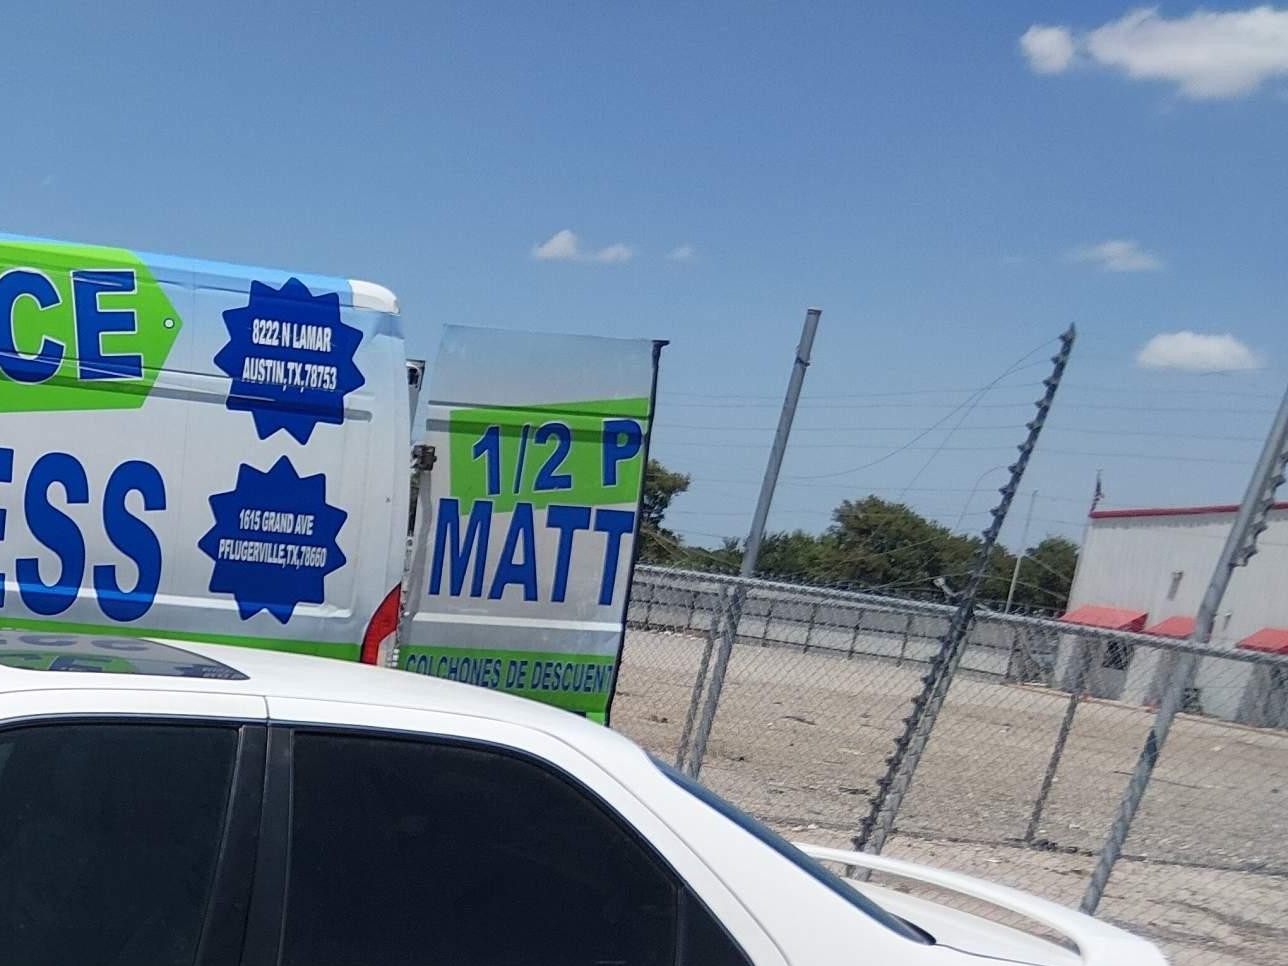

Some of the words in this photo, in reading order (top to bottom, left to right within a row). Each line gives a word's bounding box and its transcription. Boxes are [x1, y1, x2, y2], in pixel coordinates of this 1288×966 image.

[252, 318, 280, 346] 8222
[281, 322, 292, 347] N
[292, 323, 332, 352] LAMAR
[472, 420, 573, 495] 1/2
[601, 416, 643, 488] P
[239, 508, 261, 531] 1615
[261, 511, 294, 534] GRAND
[294, 513, 315, 536] AVE
[427, 497, 636, 606] MATT
[505, 659, 528, 689] DE
